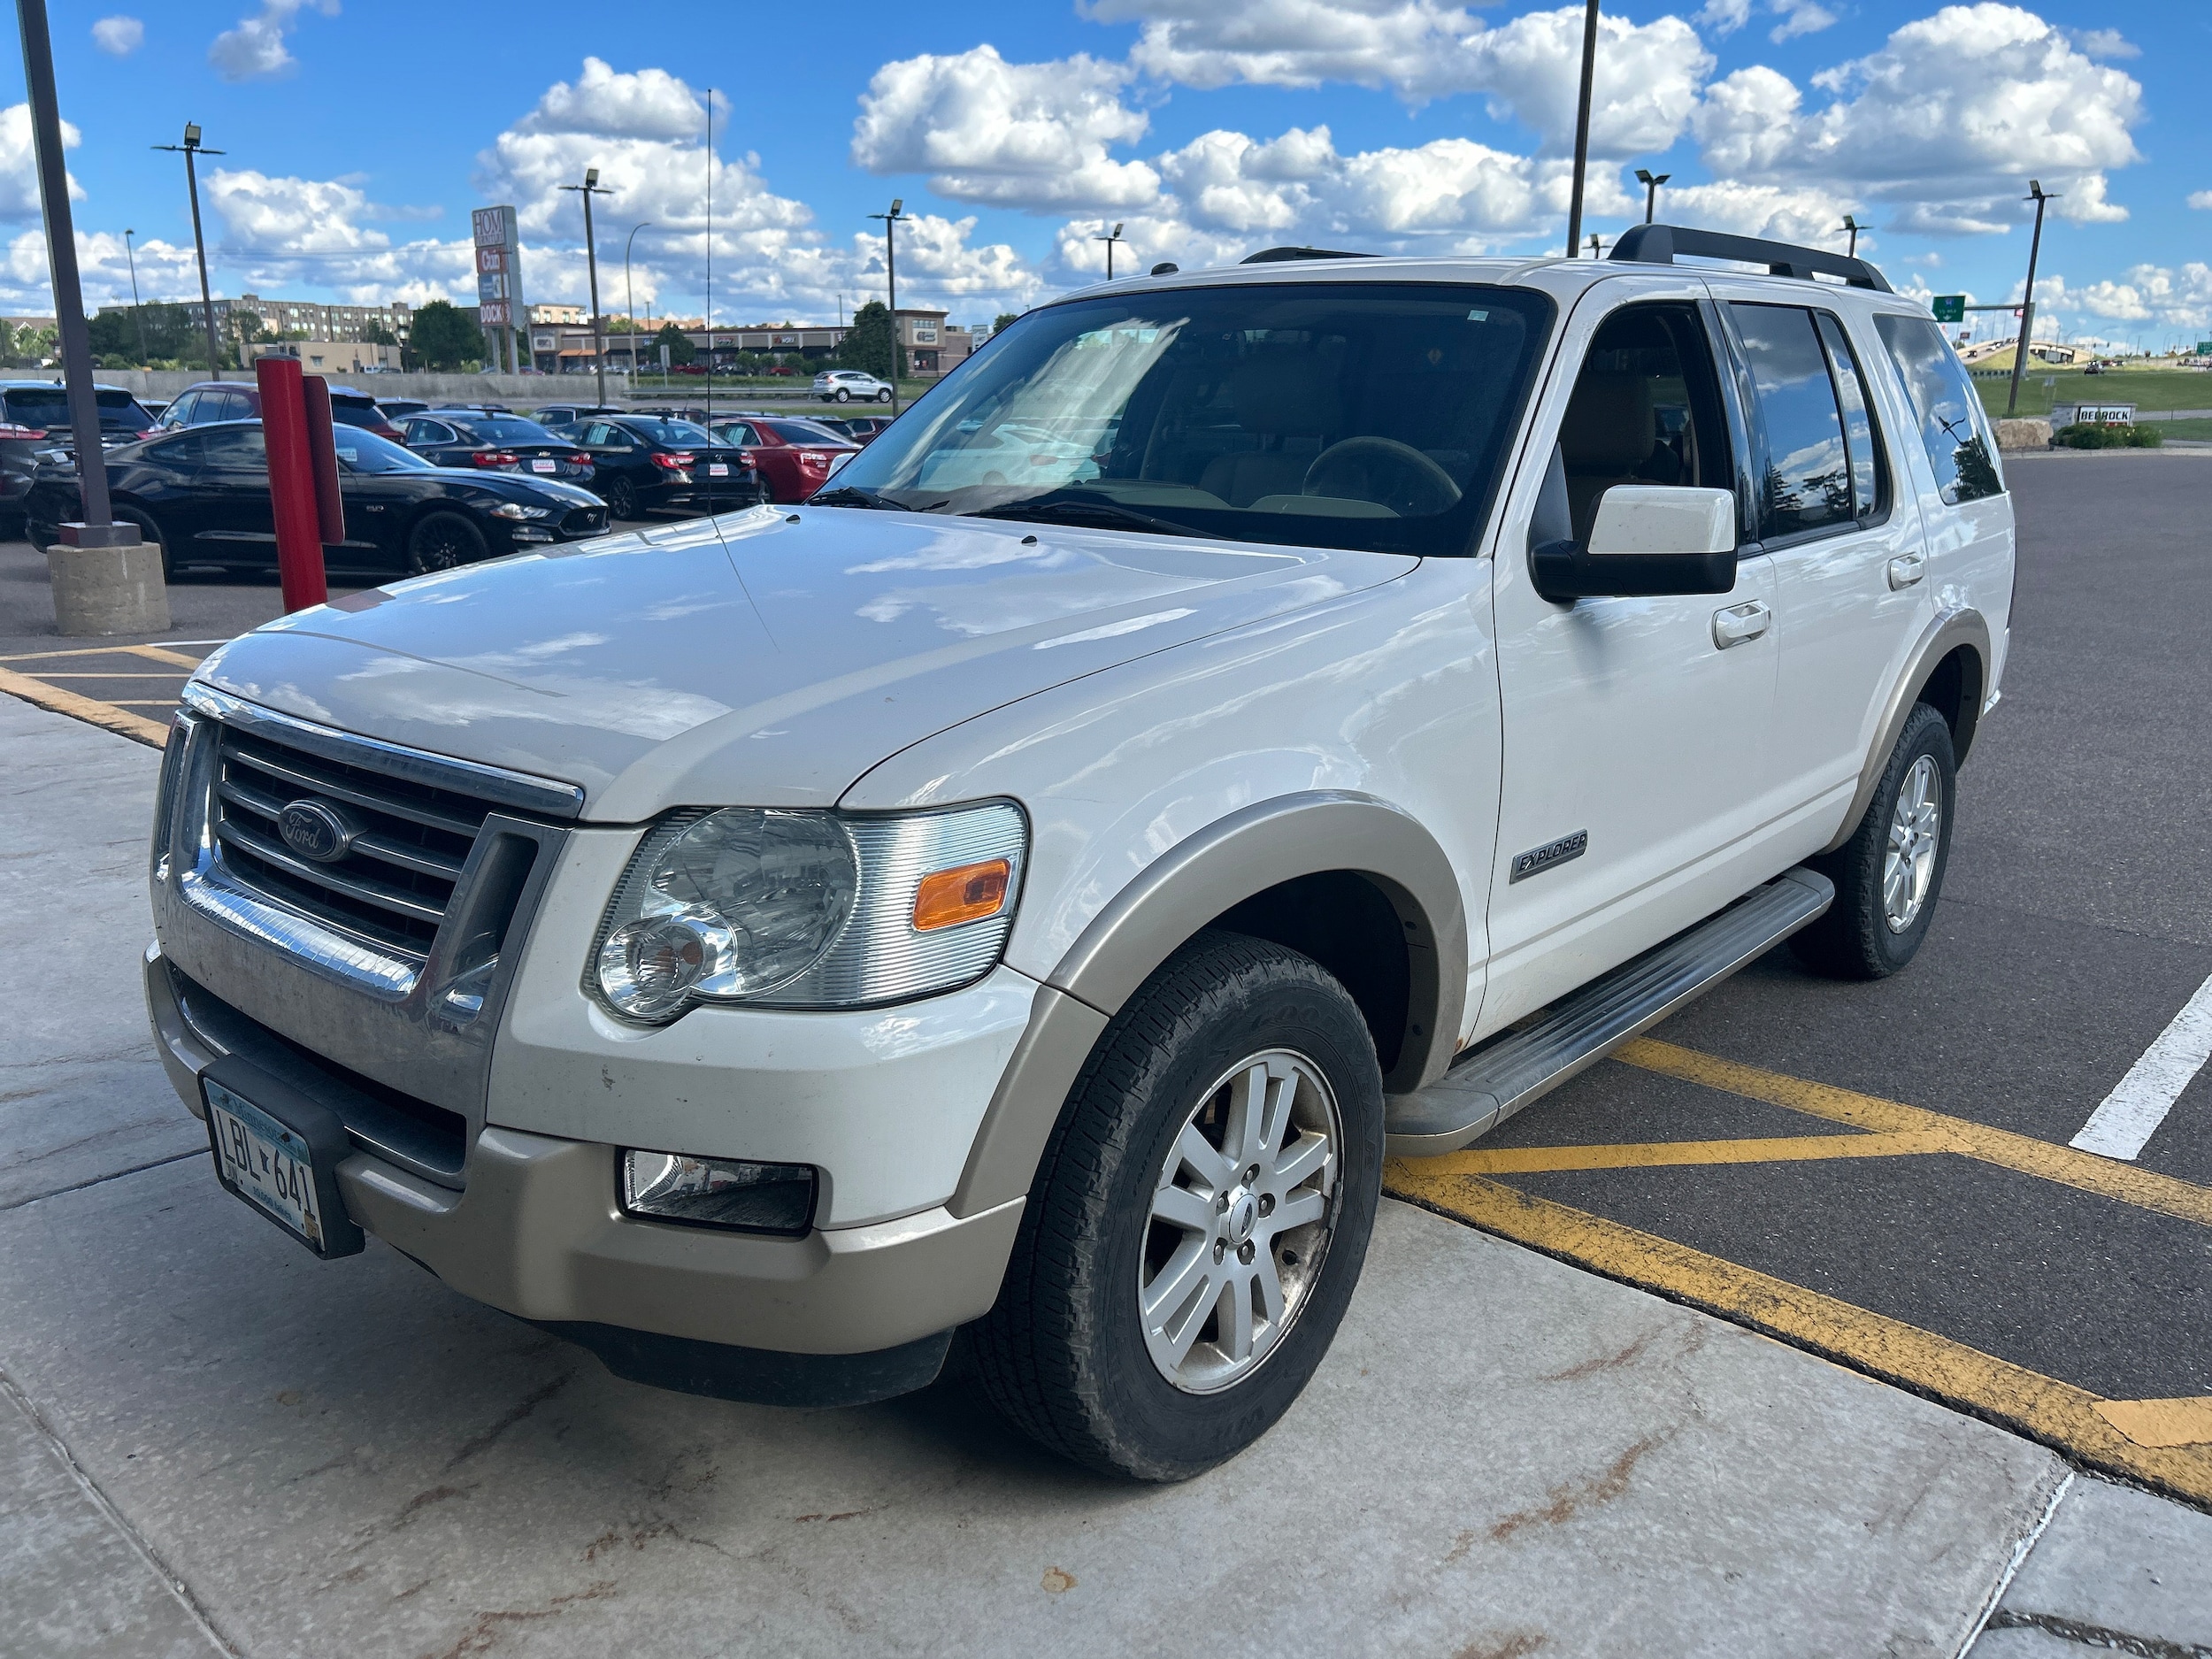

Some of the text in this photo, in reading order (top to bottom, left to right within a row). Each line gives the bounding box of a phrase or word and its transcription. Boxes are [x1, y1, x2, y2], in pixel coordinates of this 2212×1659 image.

[473, 210, 502, 235] HOM
[480, 303, 503, 324] DOCK
[285, 810, 321, 849] Ford
[1518, 833, 1586, 872] EXPLORER
